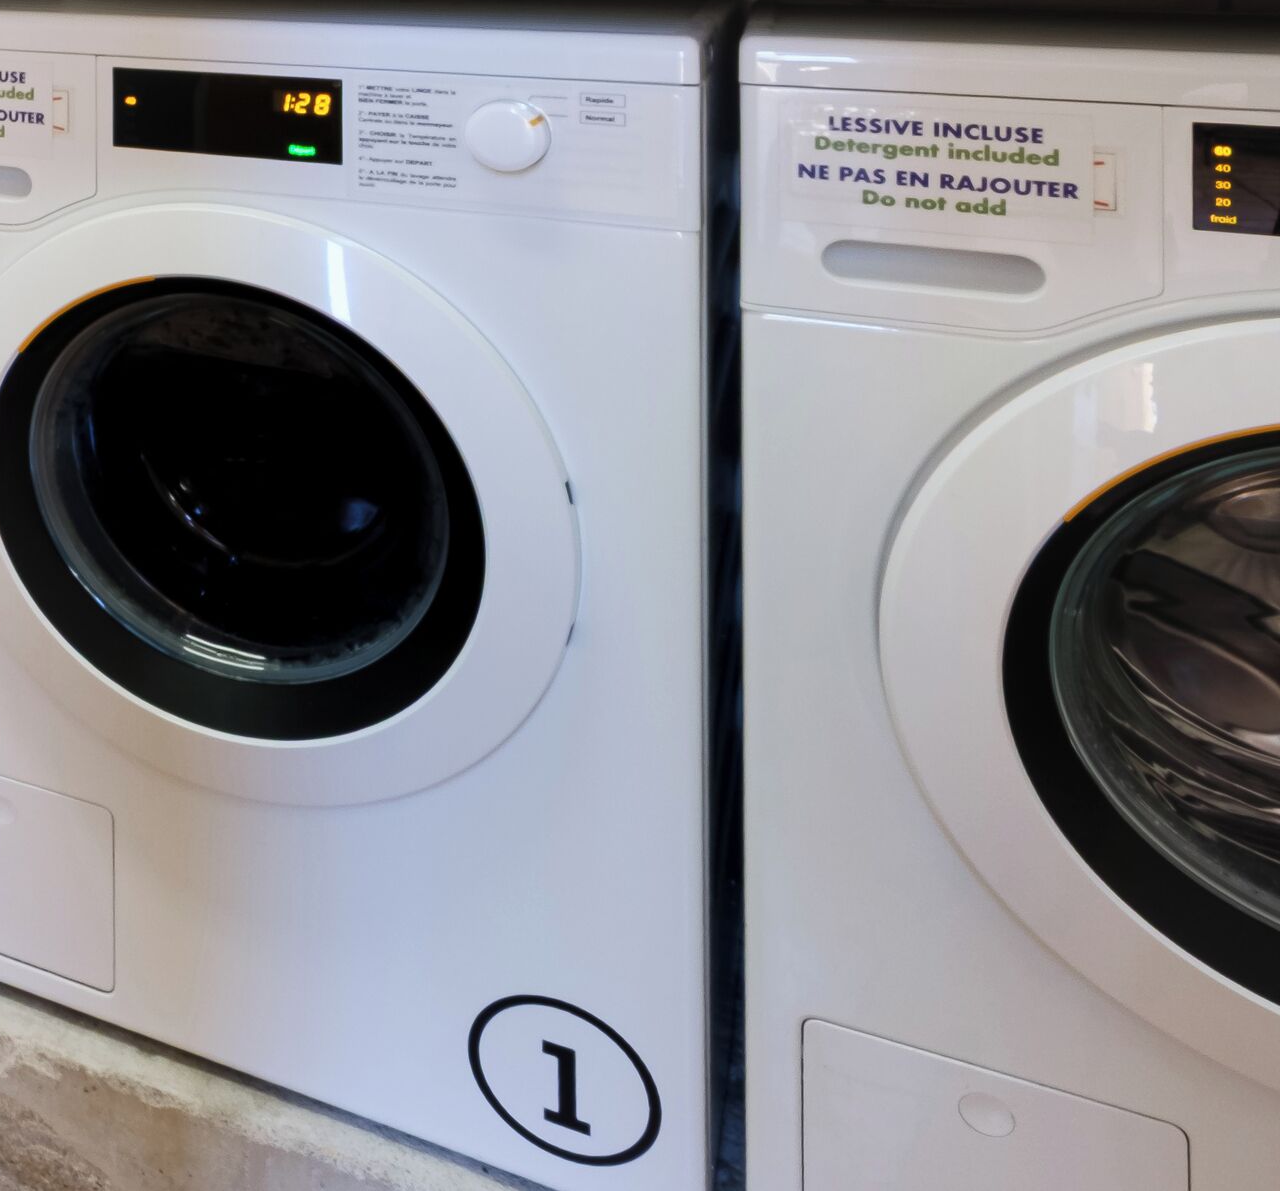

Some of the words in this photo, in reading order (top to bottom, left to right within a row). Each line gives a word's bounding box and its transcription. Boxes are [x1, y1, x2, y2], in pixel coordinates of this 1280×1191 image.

[283, 92, 331, 115] 1:28
[828, 116, 924, 136] LESSIVE
[933, 121, 1044, 144] INCLUSE
[814, 136, 939, 160] Detergent
[948, 143, 1060, 166] included
[798, 163, 829, 180] NE
[839, 166, 886, 184] PAS
[896, 171, 929, 188] EN
[940, 174, 1079, 200] RAJOUTER
[1215, 164, 1231, 173] 40
[1215, 180, 1231, 190] 30
[862, 190, 895, 207] Do
[905, 197, 947, 211] not
[955, 198, 1006, 216] add
[1215, 197, 1231, 207] 20
[542, 1039, 591, 1136] 1
